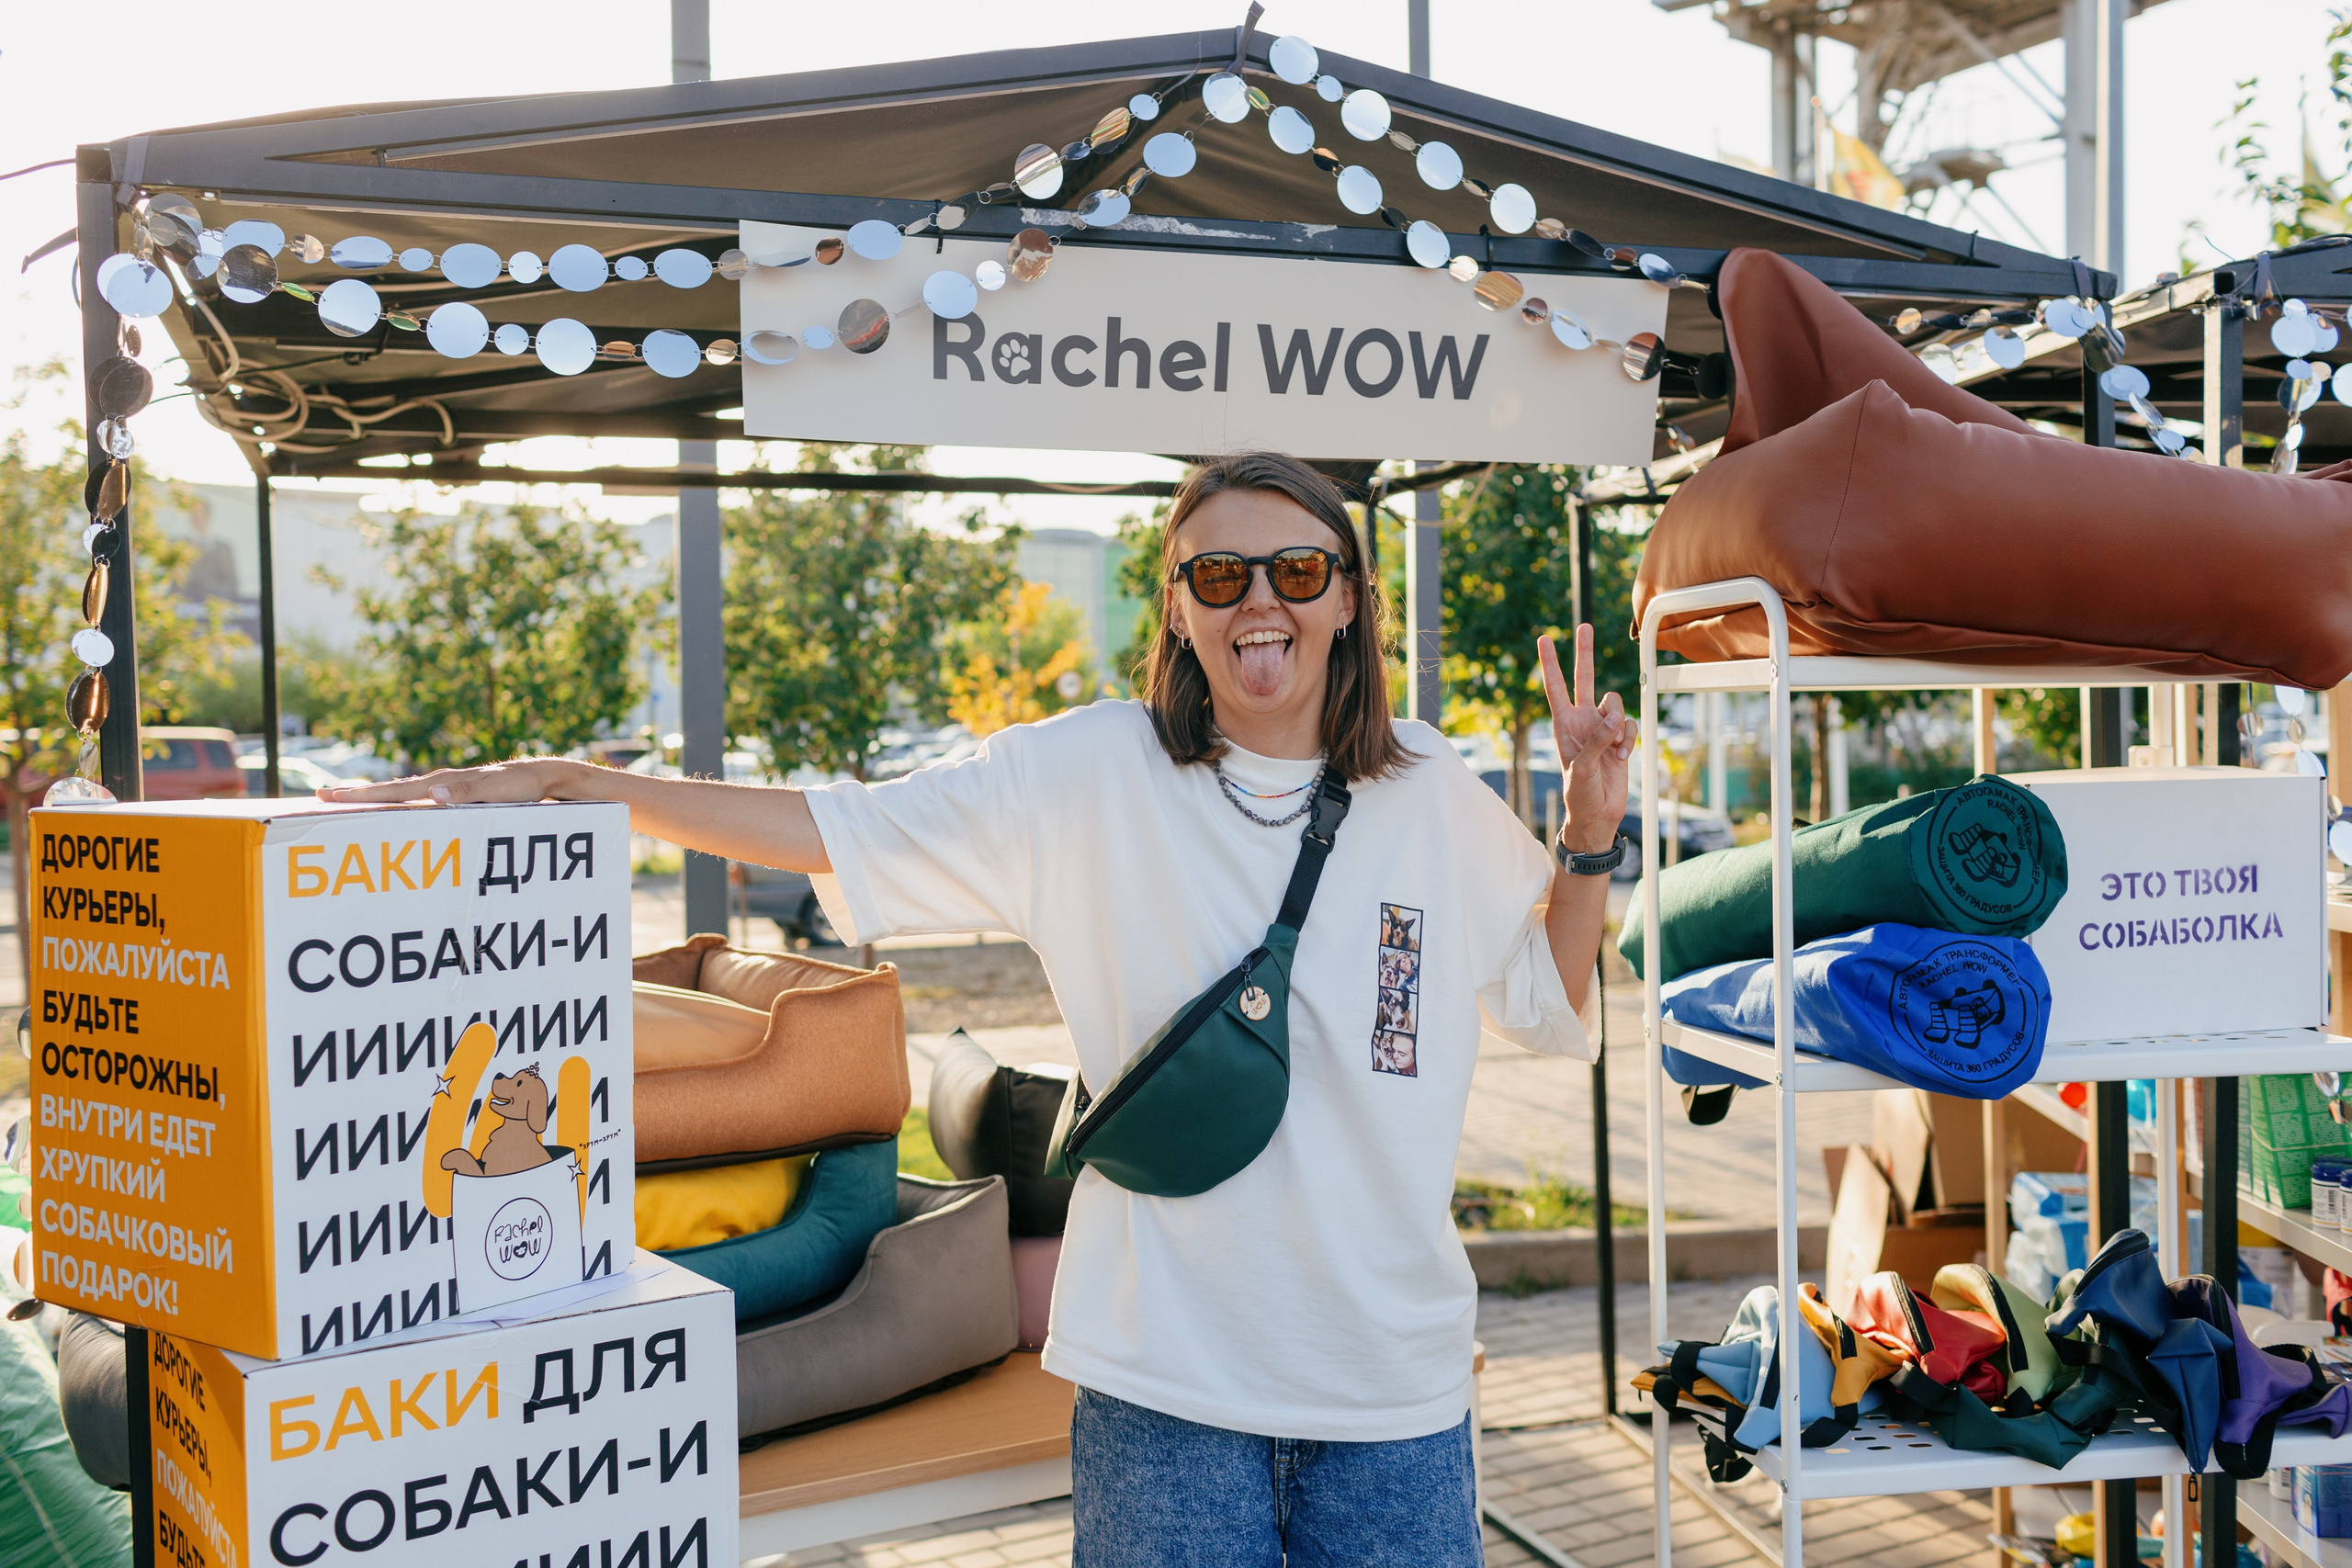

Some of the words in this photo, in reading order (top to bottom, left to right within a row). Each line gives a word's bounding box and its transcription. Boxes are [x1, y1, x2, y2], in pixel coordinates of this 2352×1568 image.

[933, 311, 1230, 392] Rachel
[1257, 323, 1490, 400] WOW
[1956, 786, 2018, 807] АВТОГАМАК
[1987, 799, 2016, 825] RACHEL
[41, 834, 160, 873] ДОРОГИЕ
[288, 838, 460, 898] БАКИ
[479, 831, 594, 897] ДЛЯ
[1937, 845, 1955, 886] ЗАЩИТА
[1952, 883, 1965, 898] 360
[1965, 896, 2013, 914] ГРАДУСОВ
[2100, 871, 2166, 901] ЭТО
[2174, 864, 2257, 897] ТВОЯ
[43, 886, 165, 935] КУРЬЕРЫ,
[2079, 911, 2284, 951] СОБАБОЛКА
[43, 936, 231, 990] ПОЖАЛУЙСТА
[288, 913, 607, 993] СОБАКИ-И
[1917, 965, 1958, 989] RACHEL
[1962, 961, 1988, 975] WOW
[1943, 949, 2020, 986] ТРАНСФОРМЕР
[43, 989, 140, 1034] БУДЬТЕ
[1899, 958, 1943, 1010] АВТОГАМАК
[41, 1042, 225, 1111] ОСТОРОЖНЫ,
[1925, 1049, 1964, 1073] ЗАЩИТА
[1965, 1064, 1982, 1073] 360
[1983, 1031, 2025, 1073] ГРАДУСОВ
[40, 1093, 142, 1144] ВНУТРИ
[150, 1111, 216, 1158] ЕДЕТ
[40, 1145, 165, 1203] ХРУПКИЙ
[40, 1199, 233, 1274] СОБАЧКОВЫЙ
[499, 1237, 541, 1264] WOW
[41, 1249, 178, 1315] ПОДАРОК!
[154, 1332, 206, 1412] ДОРОГИЕ
[268, 1361, 499, 1462] БАКИ
[523, 1327, 686, 1424] ДЛЯ
[155, 1386, 211, 1488] КУРЬЕРЫ,
[156, 1448, 237, 1568] ПОЖАЛУЙСТА
[269, 1419, 708, 1567] СОБАКИ-И
